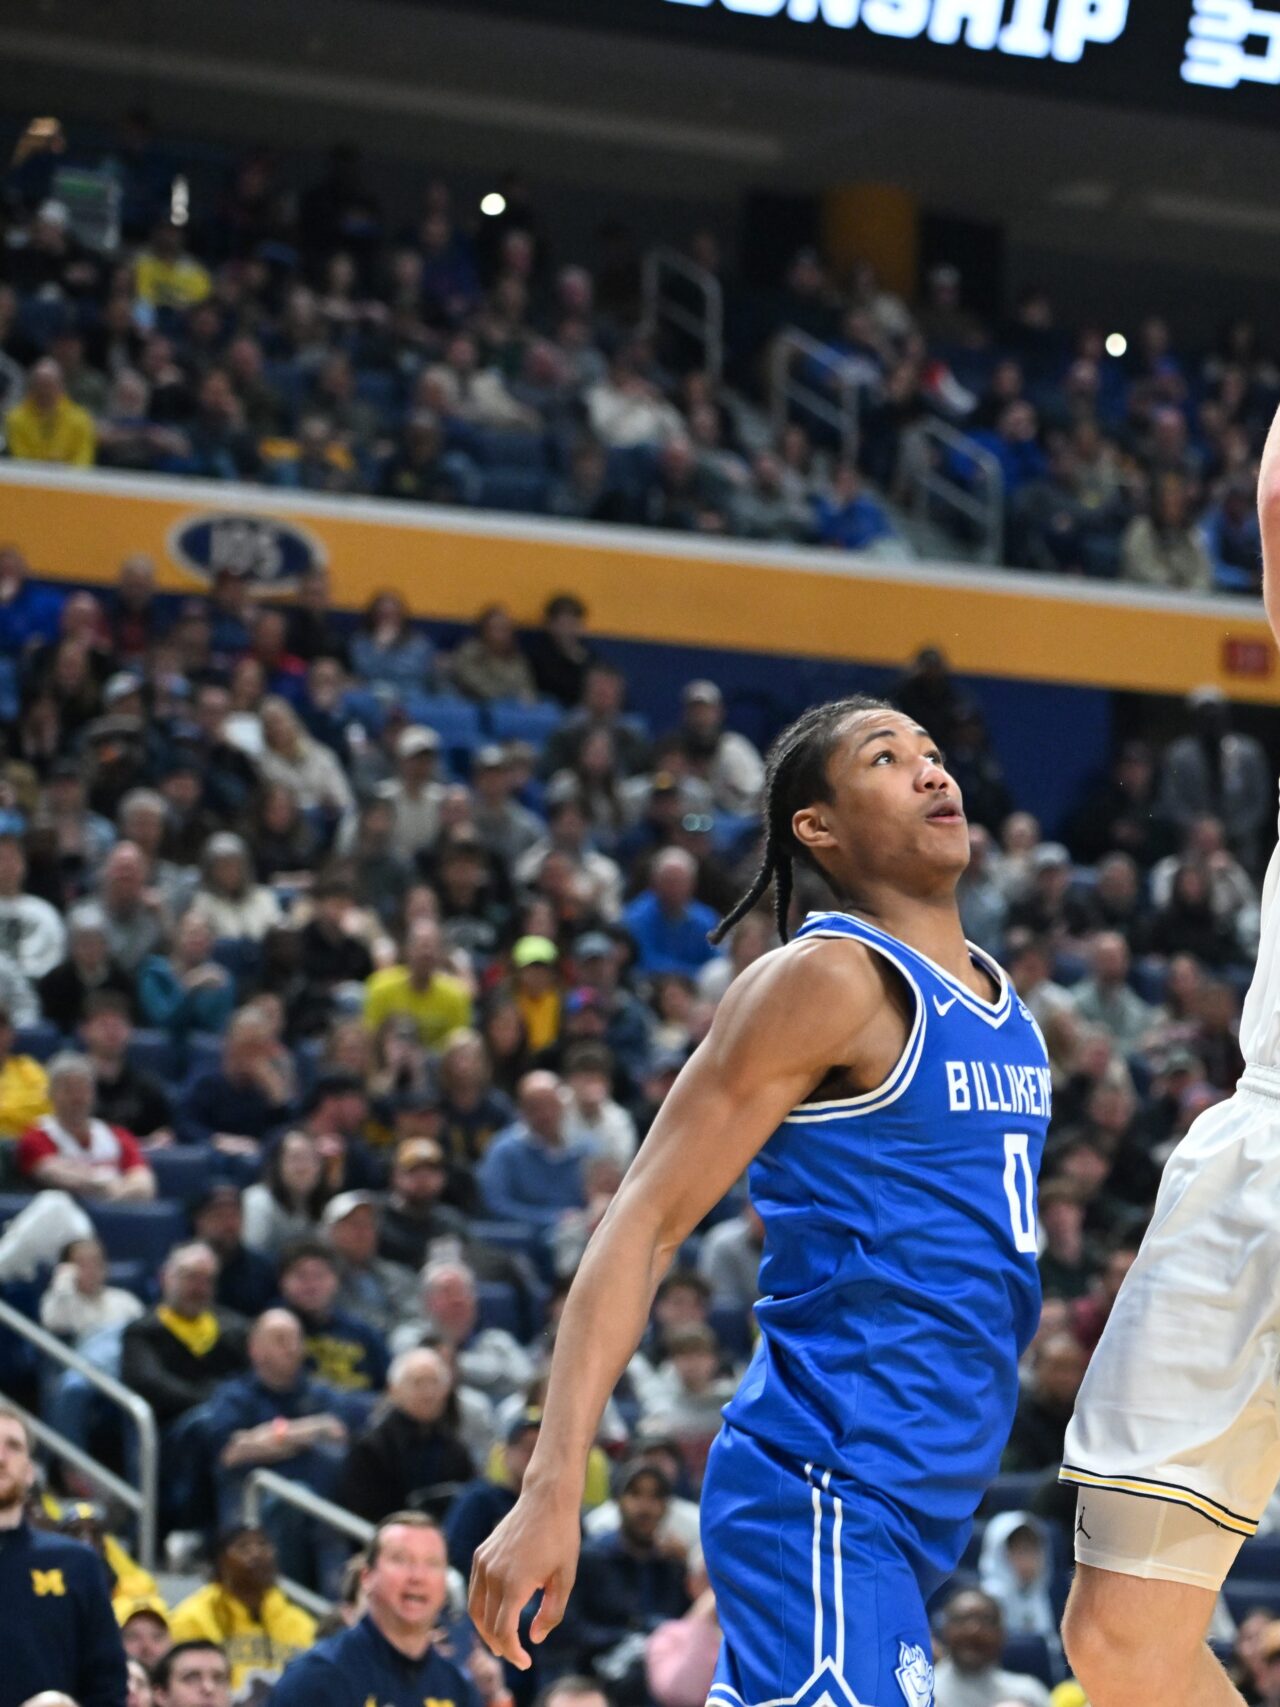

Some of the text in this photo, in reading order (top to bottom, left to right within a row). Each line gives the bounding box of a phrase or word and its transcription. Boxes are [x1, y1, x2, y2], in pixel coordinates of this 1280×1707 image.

[945, 1060, 1052, 1117] BILLIKEN
[1003, 1133, 1037, 1253] 0
[31, 1568, 66, 1597] M
